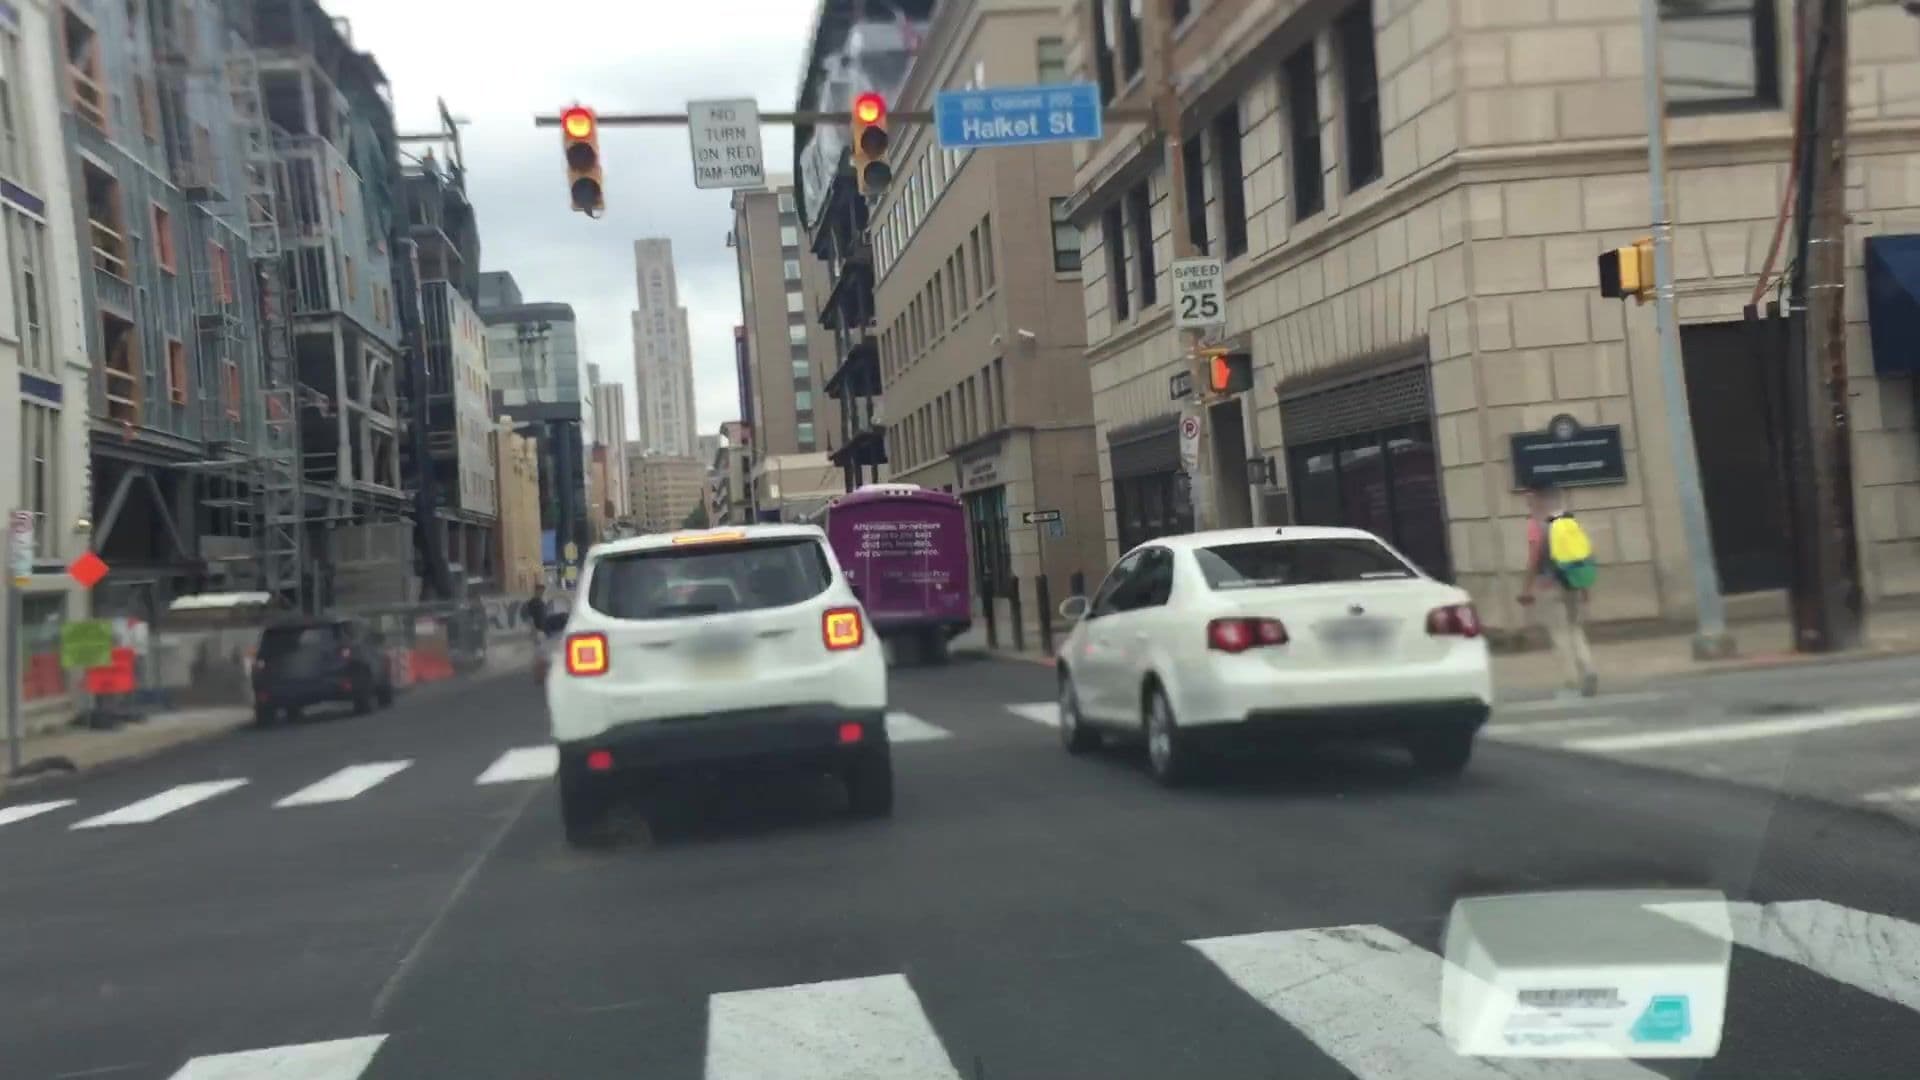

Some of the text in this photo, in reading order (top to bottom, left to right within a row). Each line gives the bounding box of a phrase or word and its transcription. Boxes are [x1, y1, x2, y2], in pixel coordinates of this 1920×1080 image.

[711, 109, 735, 121] NO
[962, 112, 1074, 140] Halket St
[704, 127, 745, 142] TURN
[699, 145, 756, 161] ON RED
[698, 164, 760, 181] 7AM-10PM
[1175, 264, 1219, 279] SPEED
[1181, 279, 1213, 293] LIMIT
[1181, 293, 1218, 320] 25
[861, 541, 894, 550] doct
